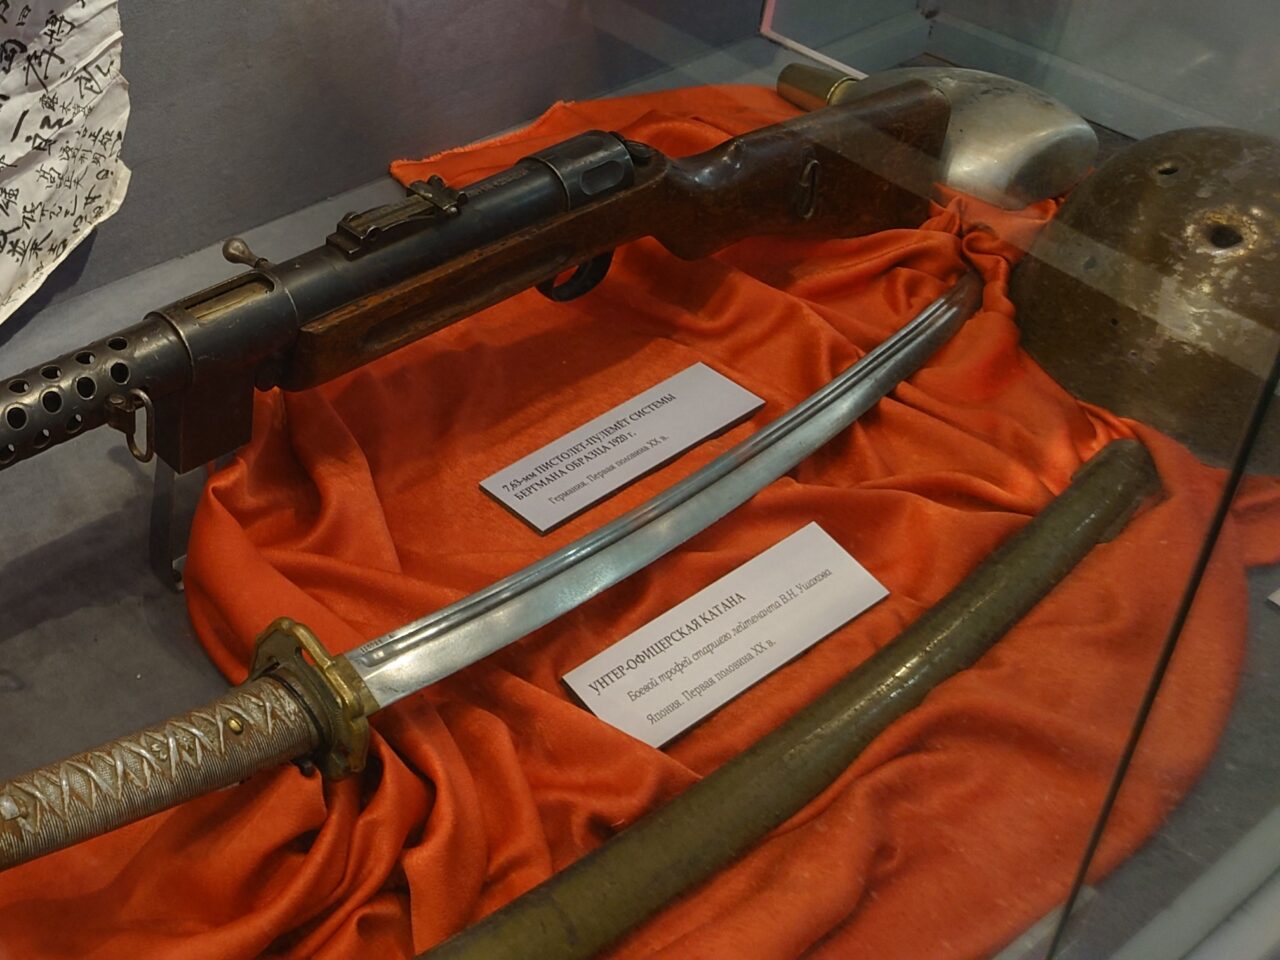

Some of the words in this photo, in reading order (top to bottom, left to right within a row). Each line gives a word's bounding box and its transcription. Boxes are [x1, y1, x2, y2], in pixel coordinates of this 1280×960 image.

[502, 471, 537, 493] 7,63-мм
[629, 393, 676, 423] СИСТЕМЫ
[514, 467, 568, 501] БЕРГМАНА
[567, 444, 611, 472] ОБРАЗЦА
[548, 480, 589, 505] Германия.
[587, 464, 616, 483] Первая
[615, 445, 650, 469] половина
[588, 618, 703, 696] УНТЕР-ОФИЦЕРСКАЯ
[701, 592, 746, 626] КАТАНА
[626, 676, 659, 702] Боевой
[658, 657, 693, 684] трофей
[691, 632, 732, 662] старшего
[731, 601, 781, 637] лейтенанта
[795, 567, 833, 593] Ушакова
[646, 700, 685, 725] Япония.
[681, 677, 716, 701] Первая
[715, 653, 754, 681] половина
[766, 638, 776, 649] в.
